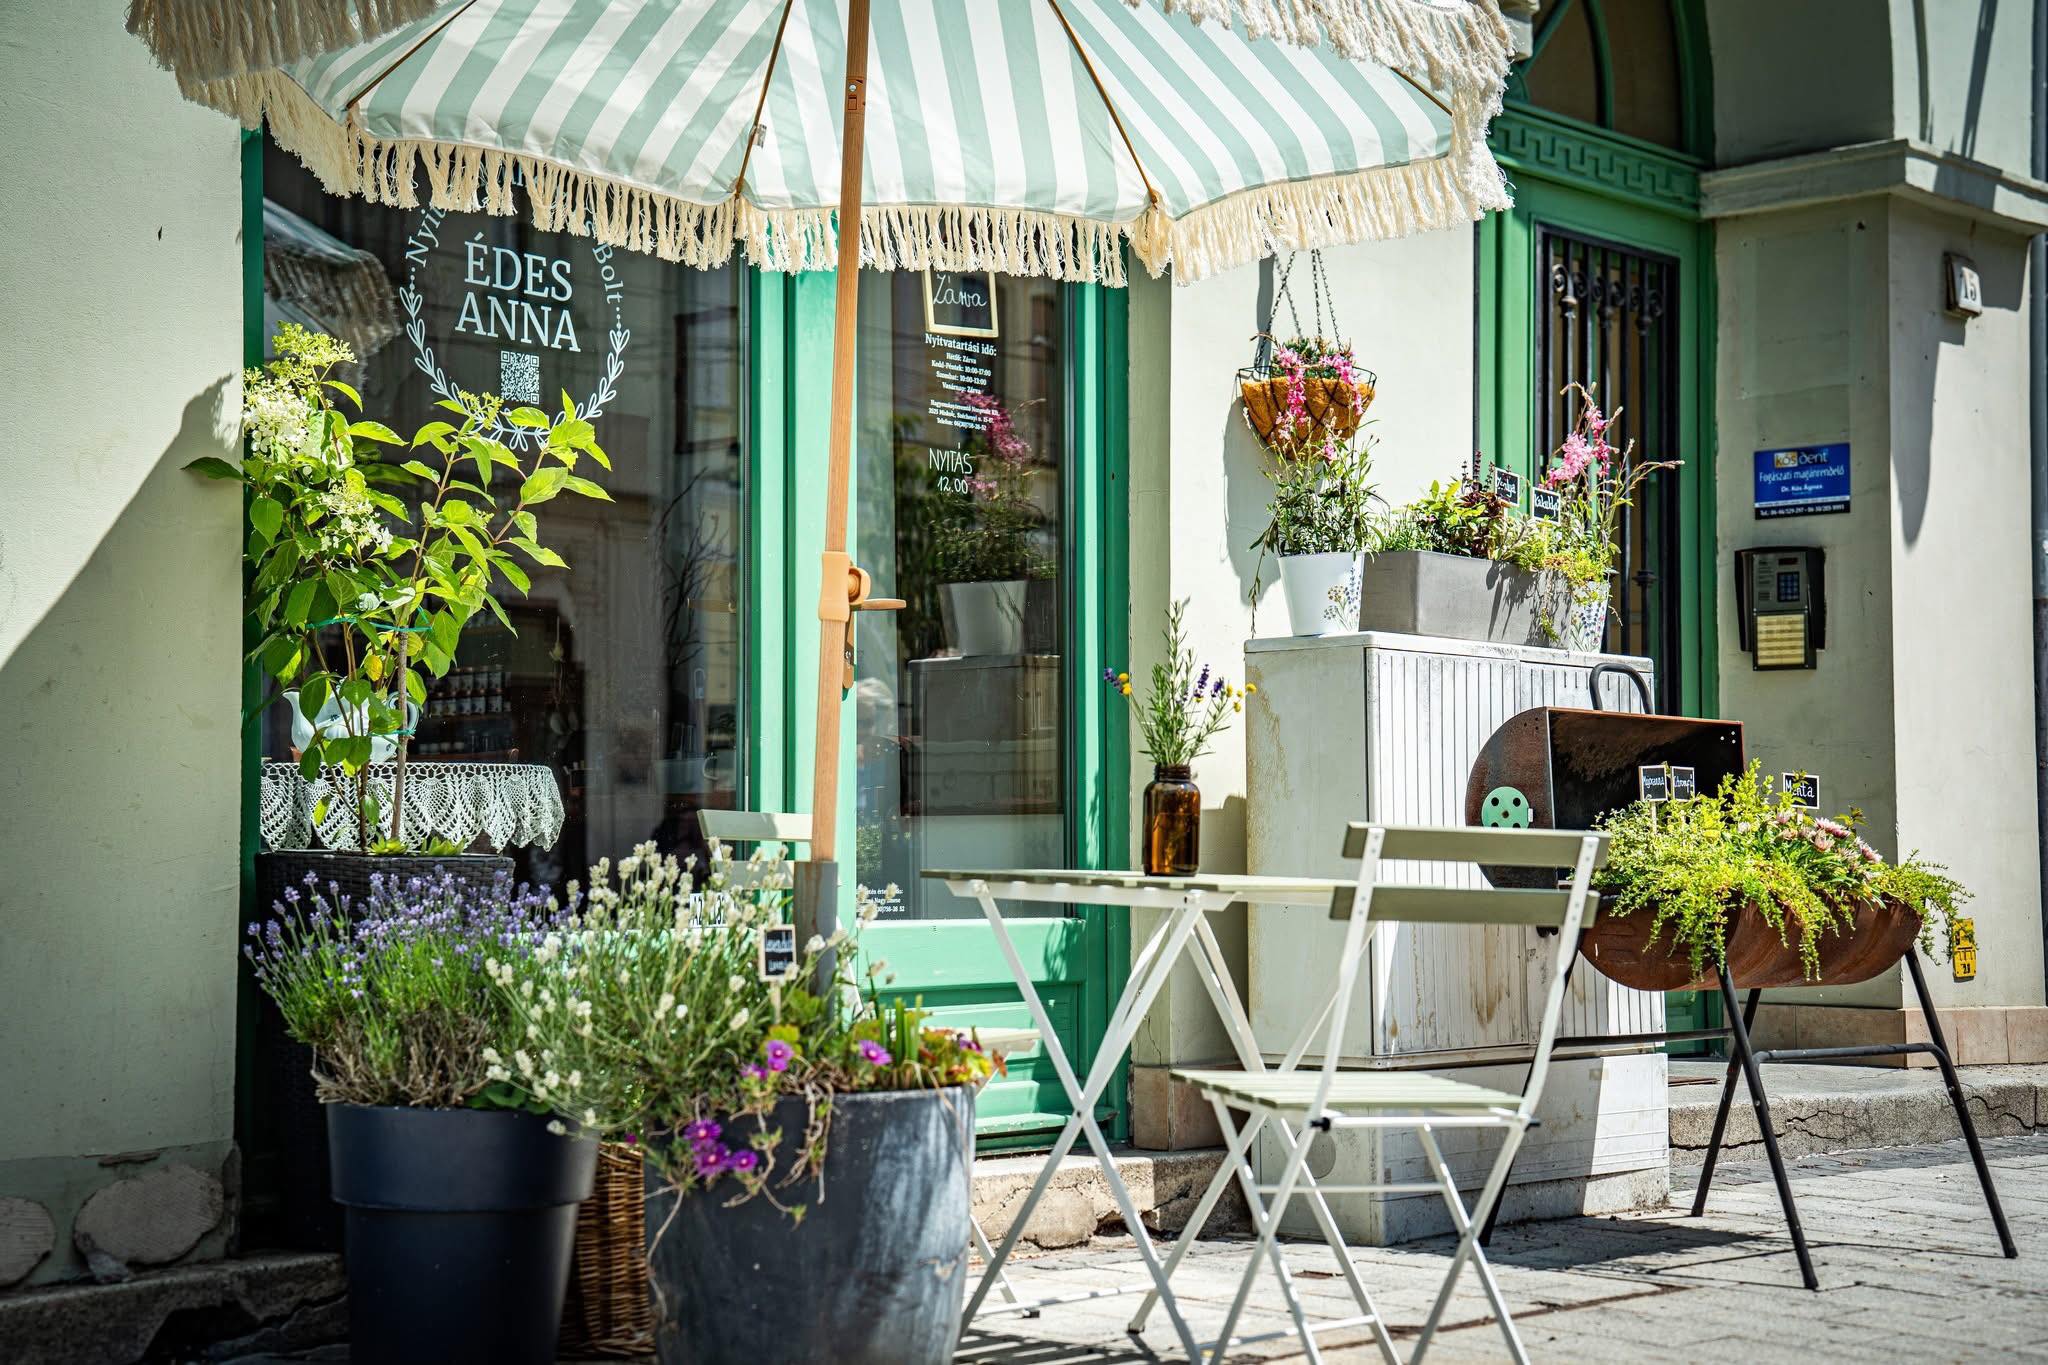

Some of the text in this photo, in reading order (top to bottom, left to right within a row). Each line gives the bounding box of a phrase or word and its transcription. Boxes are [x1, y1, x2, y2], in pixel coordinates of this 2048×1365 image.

[464, 231, 573, 302] ÉDES
[592, 242, 624, 305] Bolt
[454, 291, 582, 353] ANNA
[925, 333, 997, 357] Nyitvatartási idő:
[962, 355, 977, 365] Zárva
[929, 442, 973, 474] NYITÁS
[937, 475, 969, 495] 12.00
[1759, 464, 1845, 485] Fogászati magánrendelő
